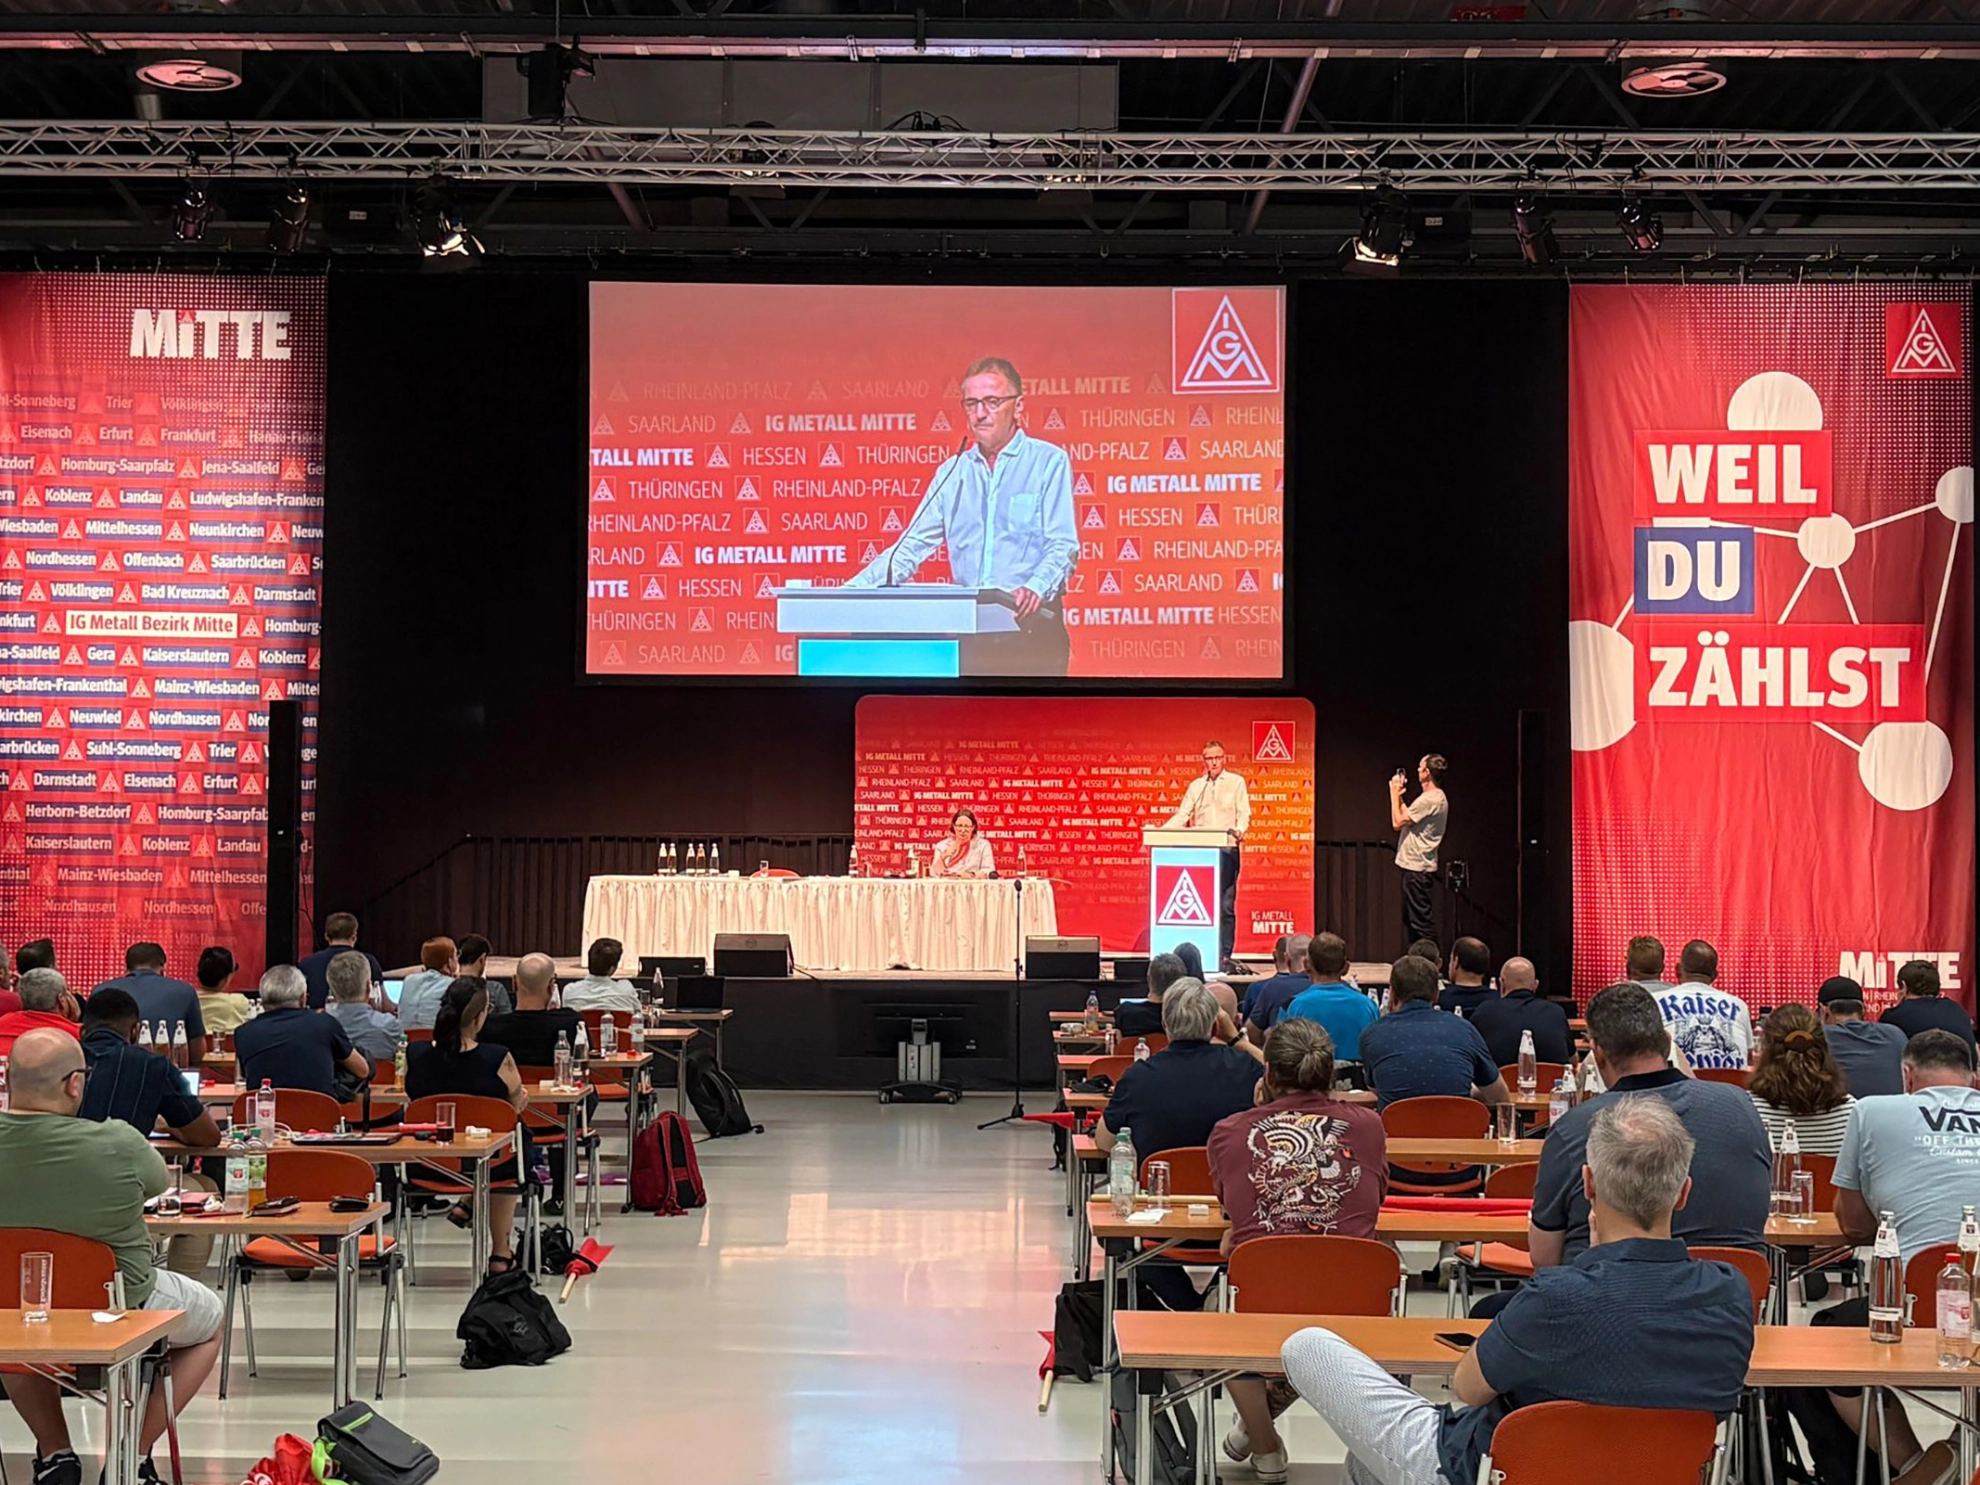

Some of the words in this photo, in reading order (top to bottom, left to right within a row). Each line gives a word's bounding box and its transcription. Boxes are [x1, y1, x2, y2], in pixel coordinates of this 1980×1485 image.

[644, 382, 790, 400] RHEINLAND-PFALZ
[842, 382, 928, 398] SAARLAND
[1075, 376, 1130, 395] MITTE
[766, 414, 784, 432] IG
[788, 414, 856, 432] METALL
[860, 414, 916, 431] MITTE
[1080, 407, 1174, 427] THÜRINGEN
[628, 416, 715, 434] SAARLAND
[21, 426, 72, 439] Eisenach
[100, 428, 134, 440] Erfurt
[161, 428, 216, 442] Frankfurt
[638, 448, 693, 466] MITTE
[744, 447, 806, 465] HESSEN
[857, 445, 950, 464] THÜRINGEN
[62, 459, 174, 474] Homburg-Saarpfalz
[202, 460, 279, 476] Jena-Saalfeld
[1648, 444, 1818, 504] WEIL
[629, 478, 722, 499] THÜRINGEN
[774, 478, 920, 498] RHEINLAND-PFALZ
[1108, 474, 1128, 493] IG
[1132, 474, 1200, 493] METALL
[1204, 474, 1262, 492] MITTE
[45, 490, 92, 503] Koblenz
[120, 490, 162, 503] Landau
[782, 512, 868, 531] SAARLAND
[1120, 507, 1182, 527] HESSEN
[86, 521, 162, 535] Mittelhessen
[190, 522, 264, 537] Neunkirchen
[26, 552, 96, 565] Nordhessen
[124, 552, 184, 566] Offenbach
[211, 554, 286, 568] Saarbrücken
[695, 546, 714, 564] IG
[718, 546, 786, 564] METALL
[792, 546, 846, 564] MITTE
[1647, 540, 1742, 601] DU
[680, 580, 742, 598] HESSEN
[1135, 574, 1222, 592] SAARLAND
[50, 582, 114, 599] Völklingen
[142, 586, 164, 598] Bad
[168, 586, 229, 600] Kreuznach
[254, 588, 316, 601] Darmstadt
[1084, 608, 1154, 626] METALL
[1158, 606, 1214, 624] MITTE
[1218, 606, 1282, 624] HESSEN
[70, 616, 86, 630] IG
[90, 616, 138, 630] Metall
[142, 617, 189, 632] Bezirk
[194, 618, 232, 632] Mitte
[88, 648, 115, 660] Gera
[143, 648, 229, 662] Kaiserslautern
[639, 645, 725, 663] SAARLAND
[776, 644, 794, 662] IG
[1091, 638, 1184, 658] THÜRINGEN
[259, 650, 306, 664] Koblenz
[1648, 630, 1911, 708] ZÄHLST
[155, 680, 259, 695] Mainz-Wiesbaden
[70, 710, 121, 723] Neuwied
[149, 711, 220, 725] Nordhausen
[87, 742, 181, 760] Suhl-Sonneberg
[208, 744, 236, 757] Trier
[34, 772, 96, 786] Darmstadt
[124, 773, 176, 787] Eisenach
[204, 774, 238, 788] Erfurt
[872, 778, 931, 787] RHEINLAND-PFALZ
[950, 779, 984, 787] SAARLAND
[1082, 780, 1108, 788] HESSEN
[1128, 780, 1164, 788] THÜRINGEN
[1263, 780, 1298, 788] SAARLAND
[860, 791, 895, 800] SAARLAND
[914, 792, 922, 800] IG
[922, 792, 950, 800] METALL
[950, 792, 974, 800] MITTE
[992, 792, 1018, 800] HESSEN
[1037, 792, 1074, 800] THÜRINGEN
[1094, 792, 1152, 800] RHEINLAND-PFALZ
[26, 804, 132, 820] Herborn-Betzdorf
[918, 804, 943, 812] HESSEN
[1019, 805, 1078, 813] RHEINLAND-PFALZ
[875, 816, 912, 824] THÜRINGEN
[1009, 818, 1044, 826] SAARLAND
[1014, 831, 1036, 839] MITTE
[26, 836, 112, 851] Kaiserslautern
[142, 838, 190, 851] Koblenz
[218, 838, 260, 852] Landau
[58, 868, 163, 882] Mainz-Wiesbaden
[190, 870, 267, 884] Mittelhessen
[45, 898, 117, 912] Nordhausen
[144, 899, 214, 914] Nordhessen
[1252, 911, 1260, 920] IG
[1262, 911, 1294, 920] METALL
[1252, 922, 1294, 934] MITTE
[1659, 992, 1741, 1022] Kaiser
